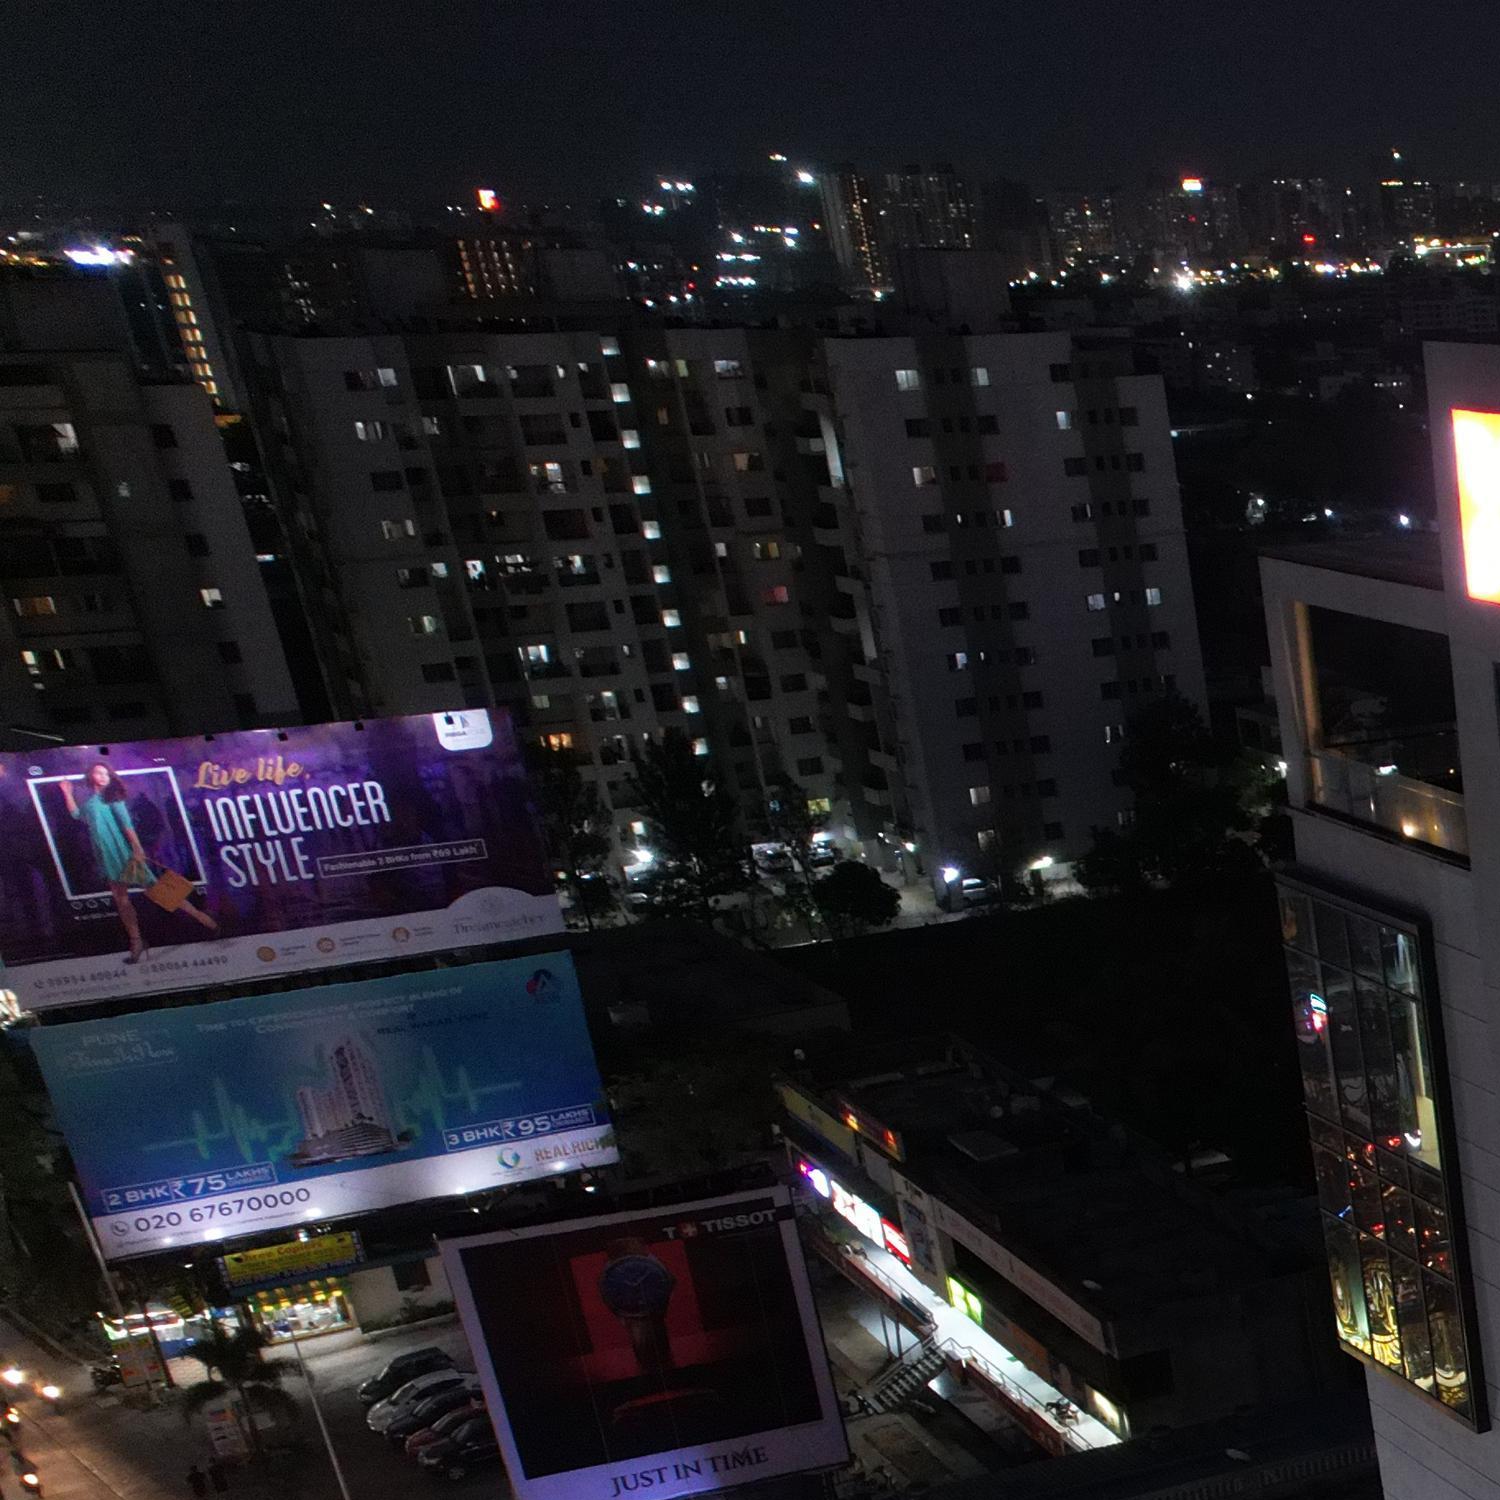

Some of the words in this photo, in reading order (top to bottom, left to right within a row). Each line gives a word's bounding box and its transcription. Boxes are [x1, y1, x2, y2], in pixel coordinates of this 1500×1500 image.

[194, 761, 252, 789] Live
[205, 781, 392, 842] INFLUENCER
[220, 837, 314, 888] STYLE
[448, 1134, 460, 1146] 3
[463, 1126, 501, 1143] BHK
[107, 1193, 122, 1207] 2
[125, 1186, 170, 1204] BHK
[134, 1212, 182, 1233] 020
[189, 1187, 311, 1223] 67670000
[701, 1209, 777, 1233] TISSOT
[611, 1466, 668, 1497] JUST
[673, 1460, 702, 1480] IN
[704, 1445, 769, 1474] TIME
